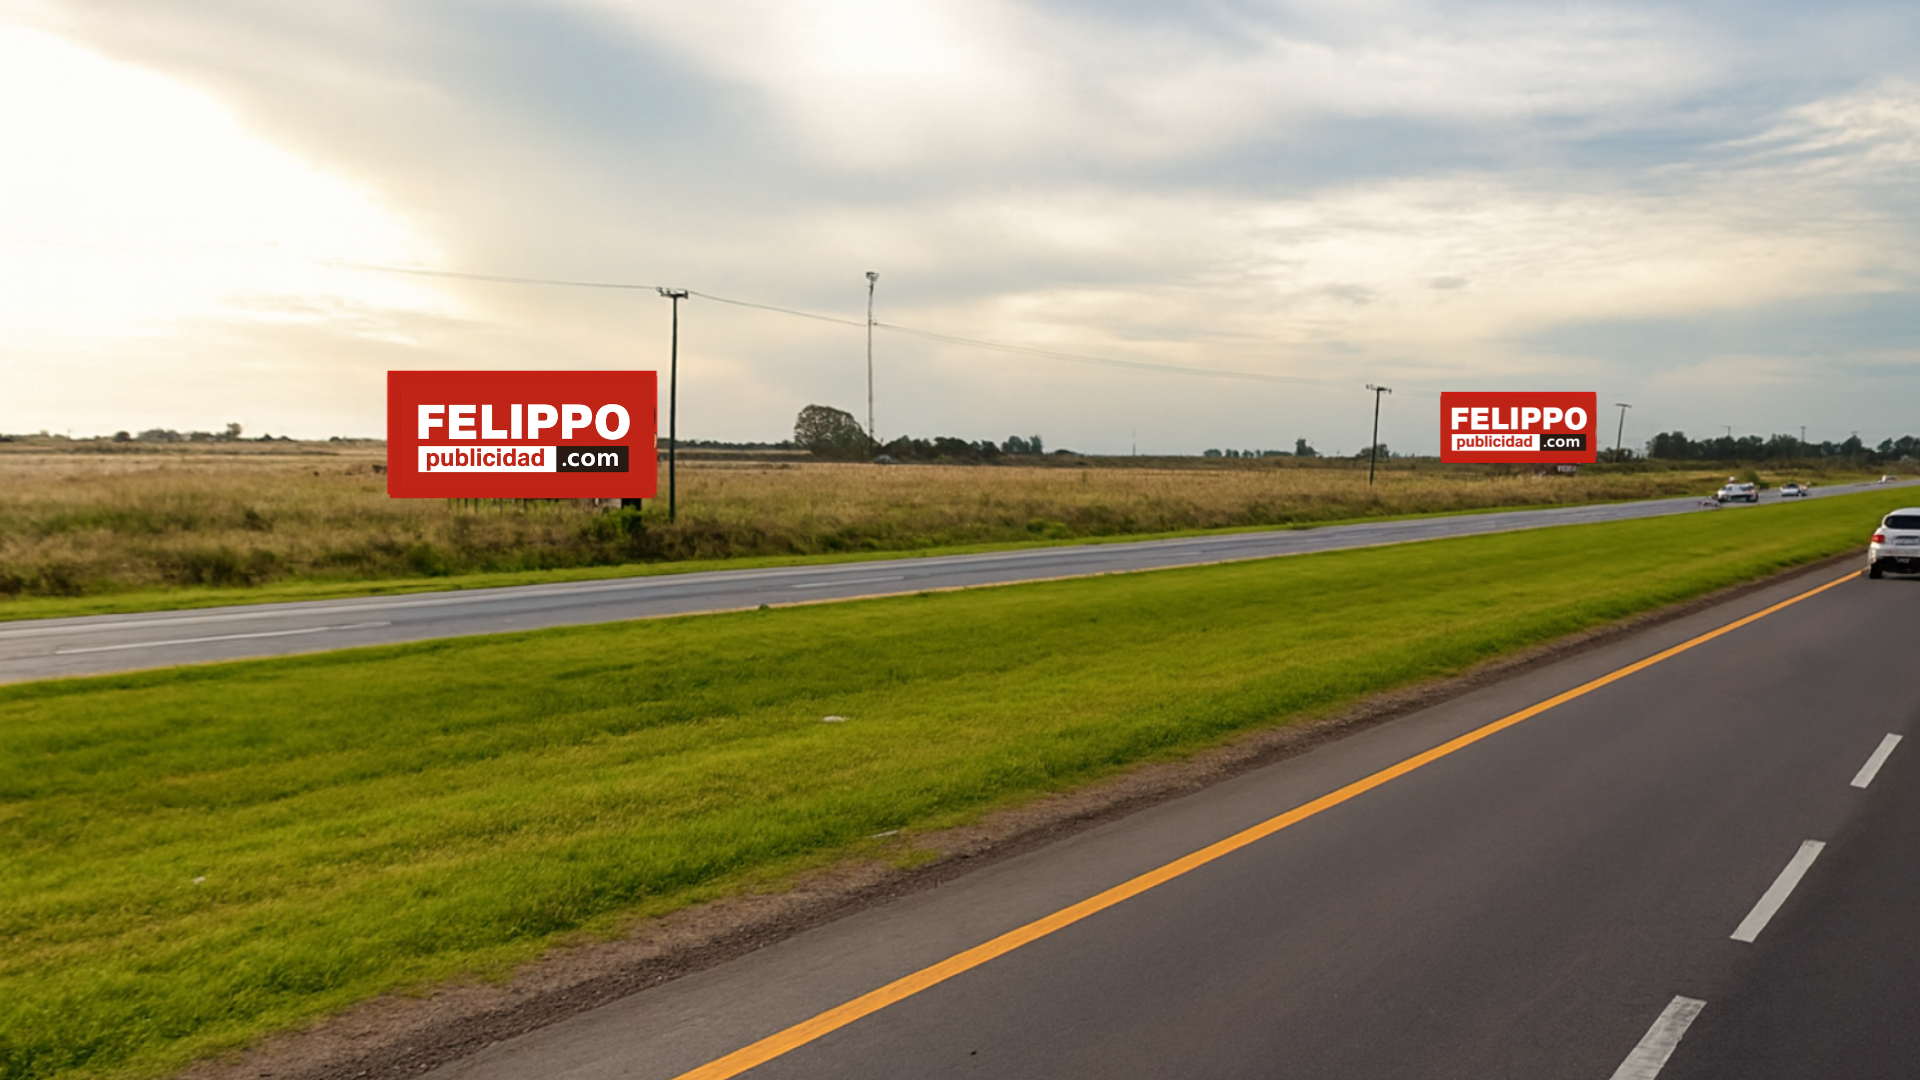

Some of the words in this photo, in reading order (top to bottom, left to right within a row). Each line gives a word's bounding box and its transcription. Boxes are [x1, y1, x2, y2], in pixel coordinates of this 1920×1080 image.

[417, 403, 631, 441] FELIPPO
[1451, 406, 1588, 431] FELIPPO
[1456, 435, 1533, 451] publicidad
[1543, 437, 1580, 448] .com
[426, 448, 545, 471] publicidad
[561, 451, 620, 467] .com
